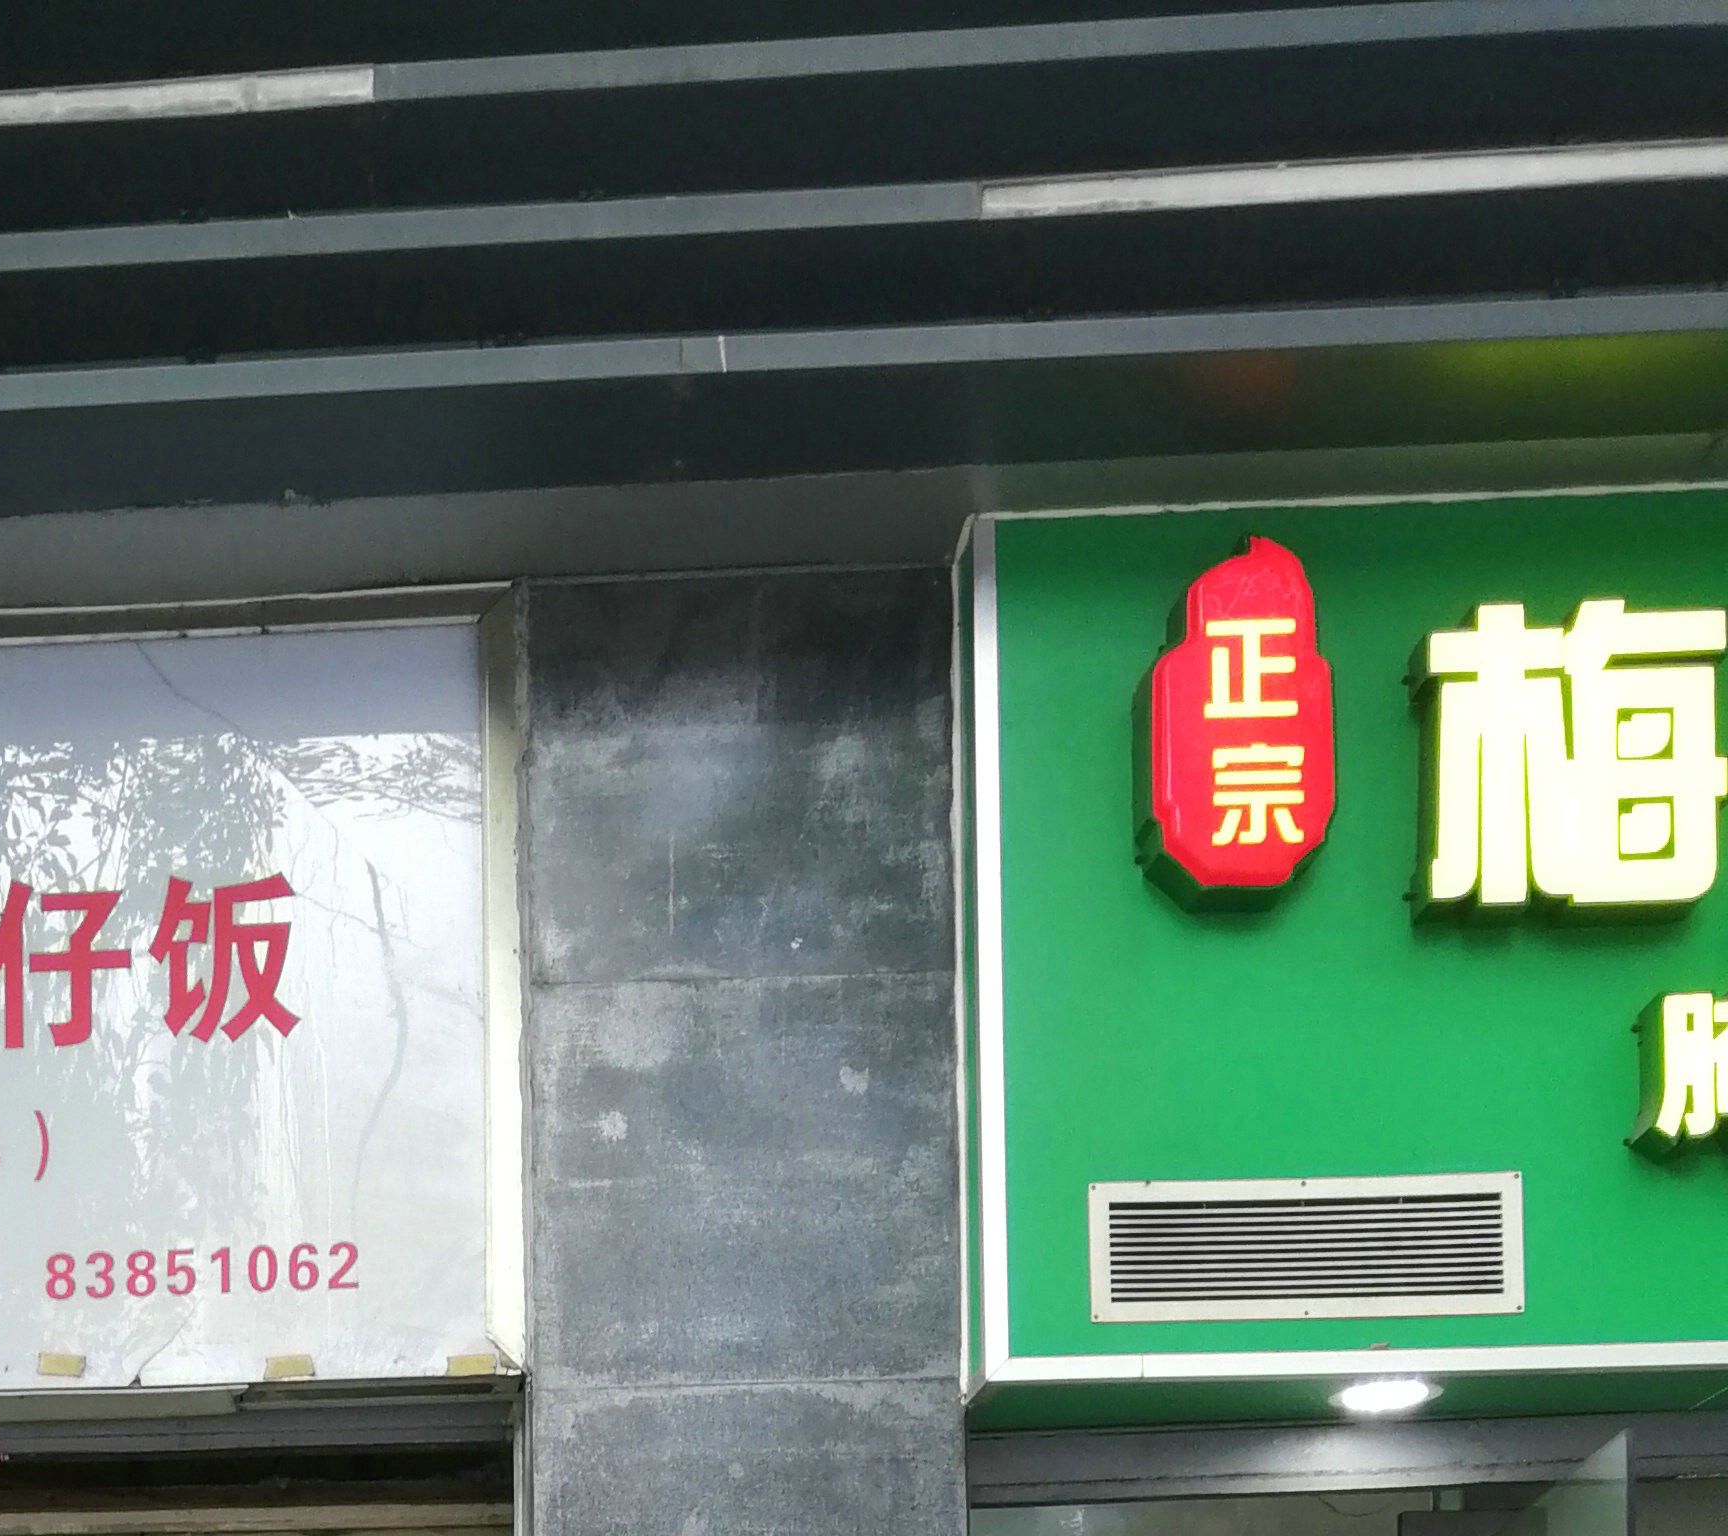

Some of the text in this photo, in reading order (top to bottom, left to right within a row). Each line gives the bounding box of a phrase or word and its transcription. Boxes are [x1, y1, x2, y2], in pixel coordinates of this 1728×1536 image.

[1203, 616, 1305, 847] 正宗
[1428, 598, 1728, 904] 梅
[44, 1241, 362, 1301] 83851062
